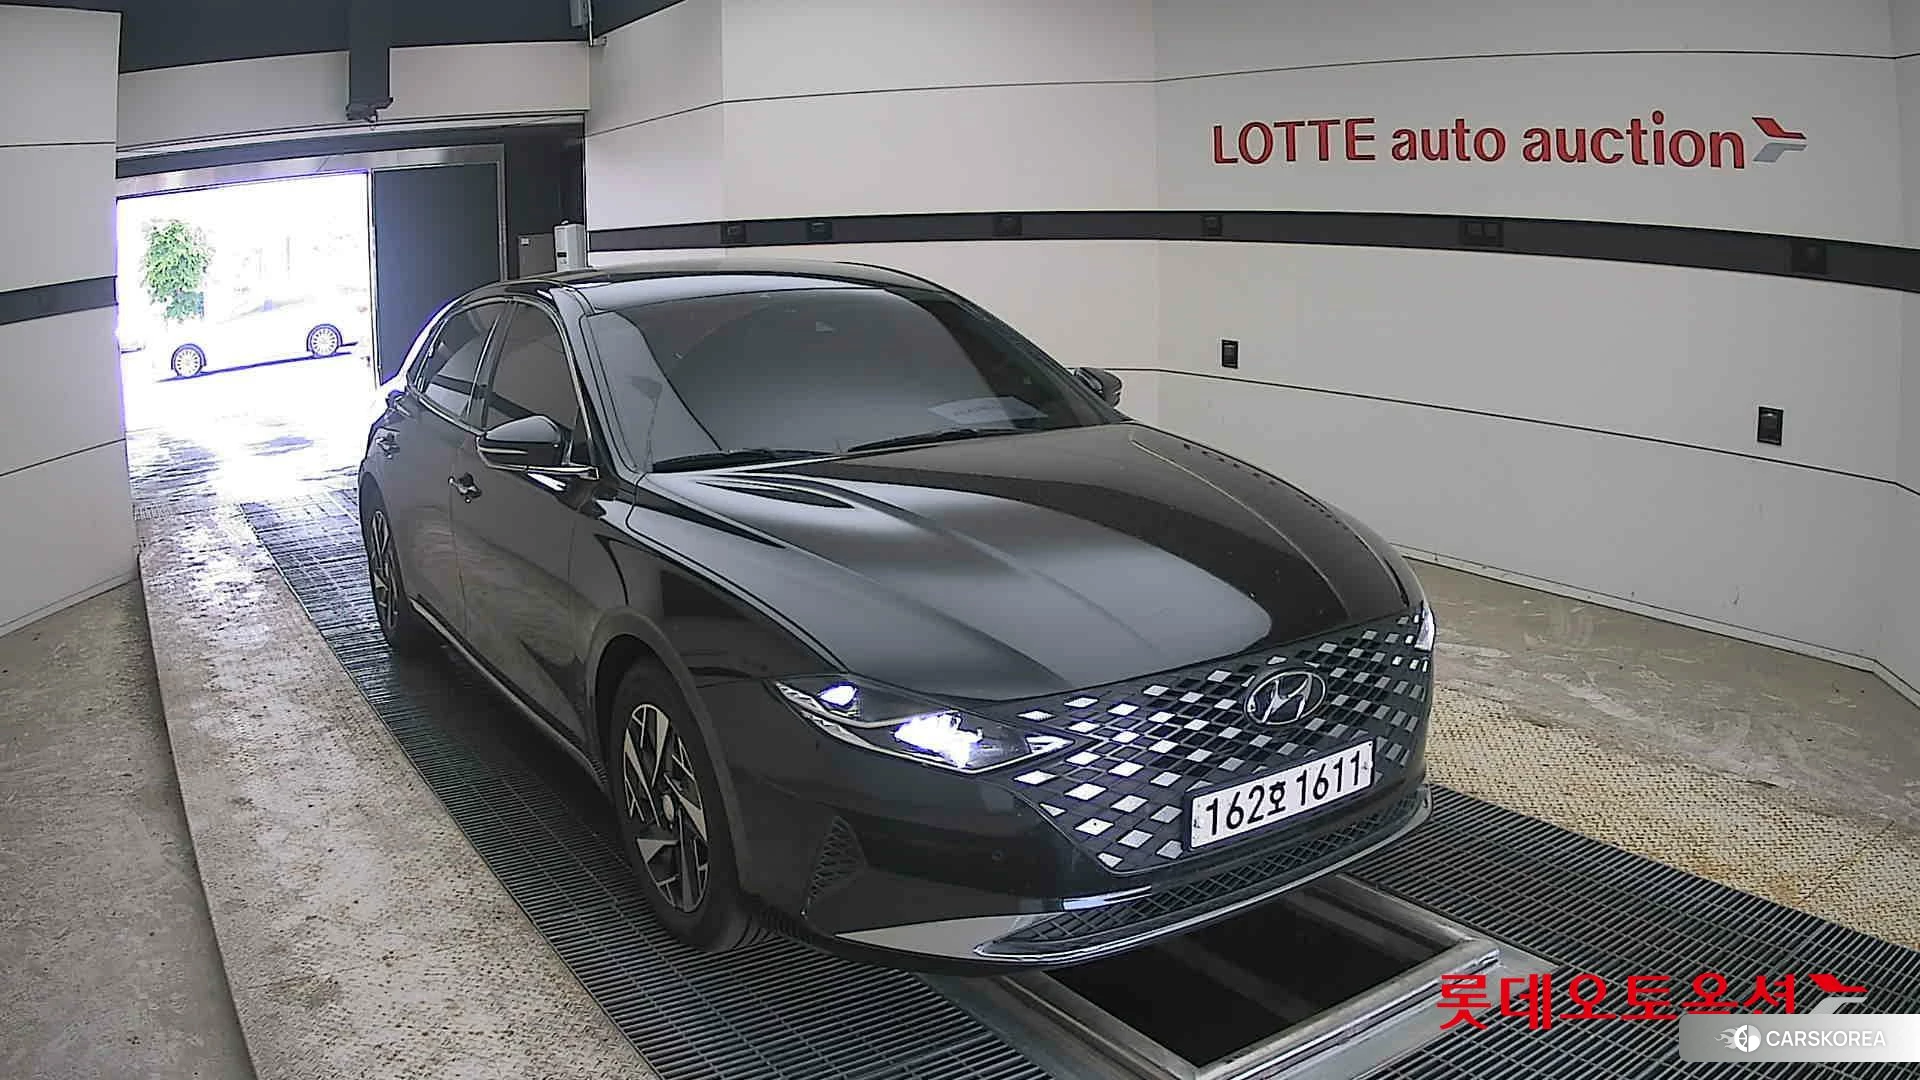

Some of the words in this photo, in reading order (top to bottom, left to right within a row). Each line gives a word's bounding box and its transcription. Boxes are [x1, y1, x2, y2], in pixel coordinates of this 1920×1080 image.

[1212, 117, 1377, 165] LOTTE
[1391, 118, 1507, 163] auto
[1521, 110, 1746, 170] auction
[1205, 780, 1287, 836] 162호
[1296, 750, 1362, 806] 1611
